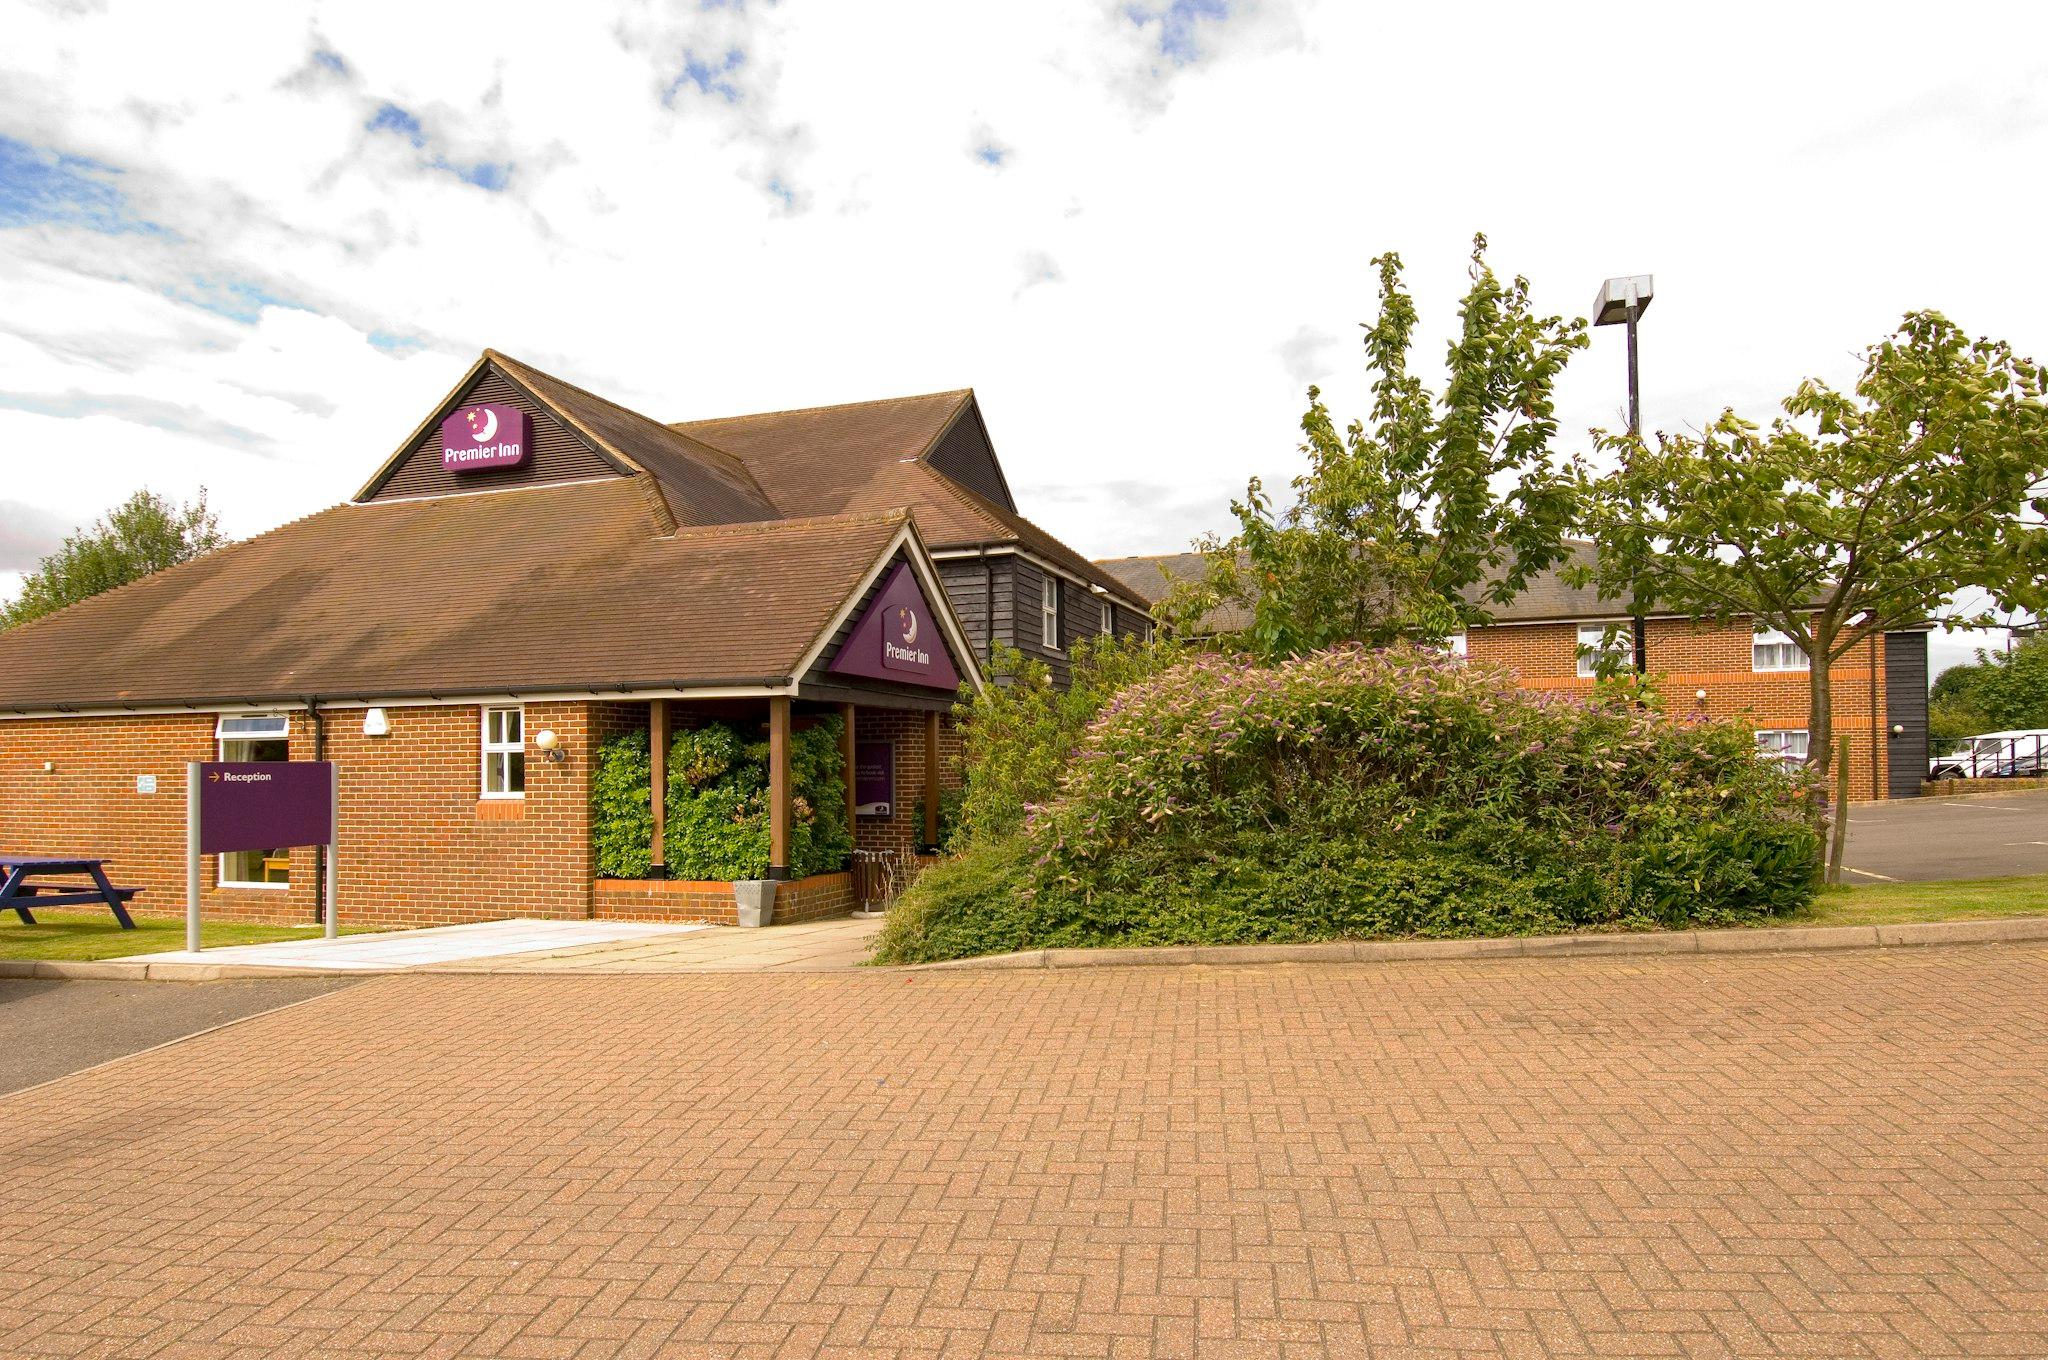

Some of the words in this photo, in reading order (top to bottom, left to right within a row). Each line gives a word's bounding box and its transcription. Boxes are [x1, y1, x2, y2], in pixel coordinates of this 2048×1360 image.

[444, 444, 497, 463] Premier
[498, 442, 520, 458] Inn
[886, 641, 917, 662] Premier
[917, 649, 929, 665] Inn
[223, 772, 272, 783] Reception
